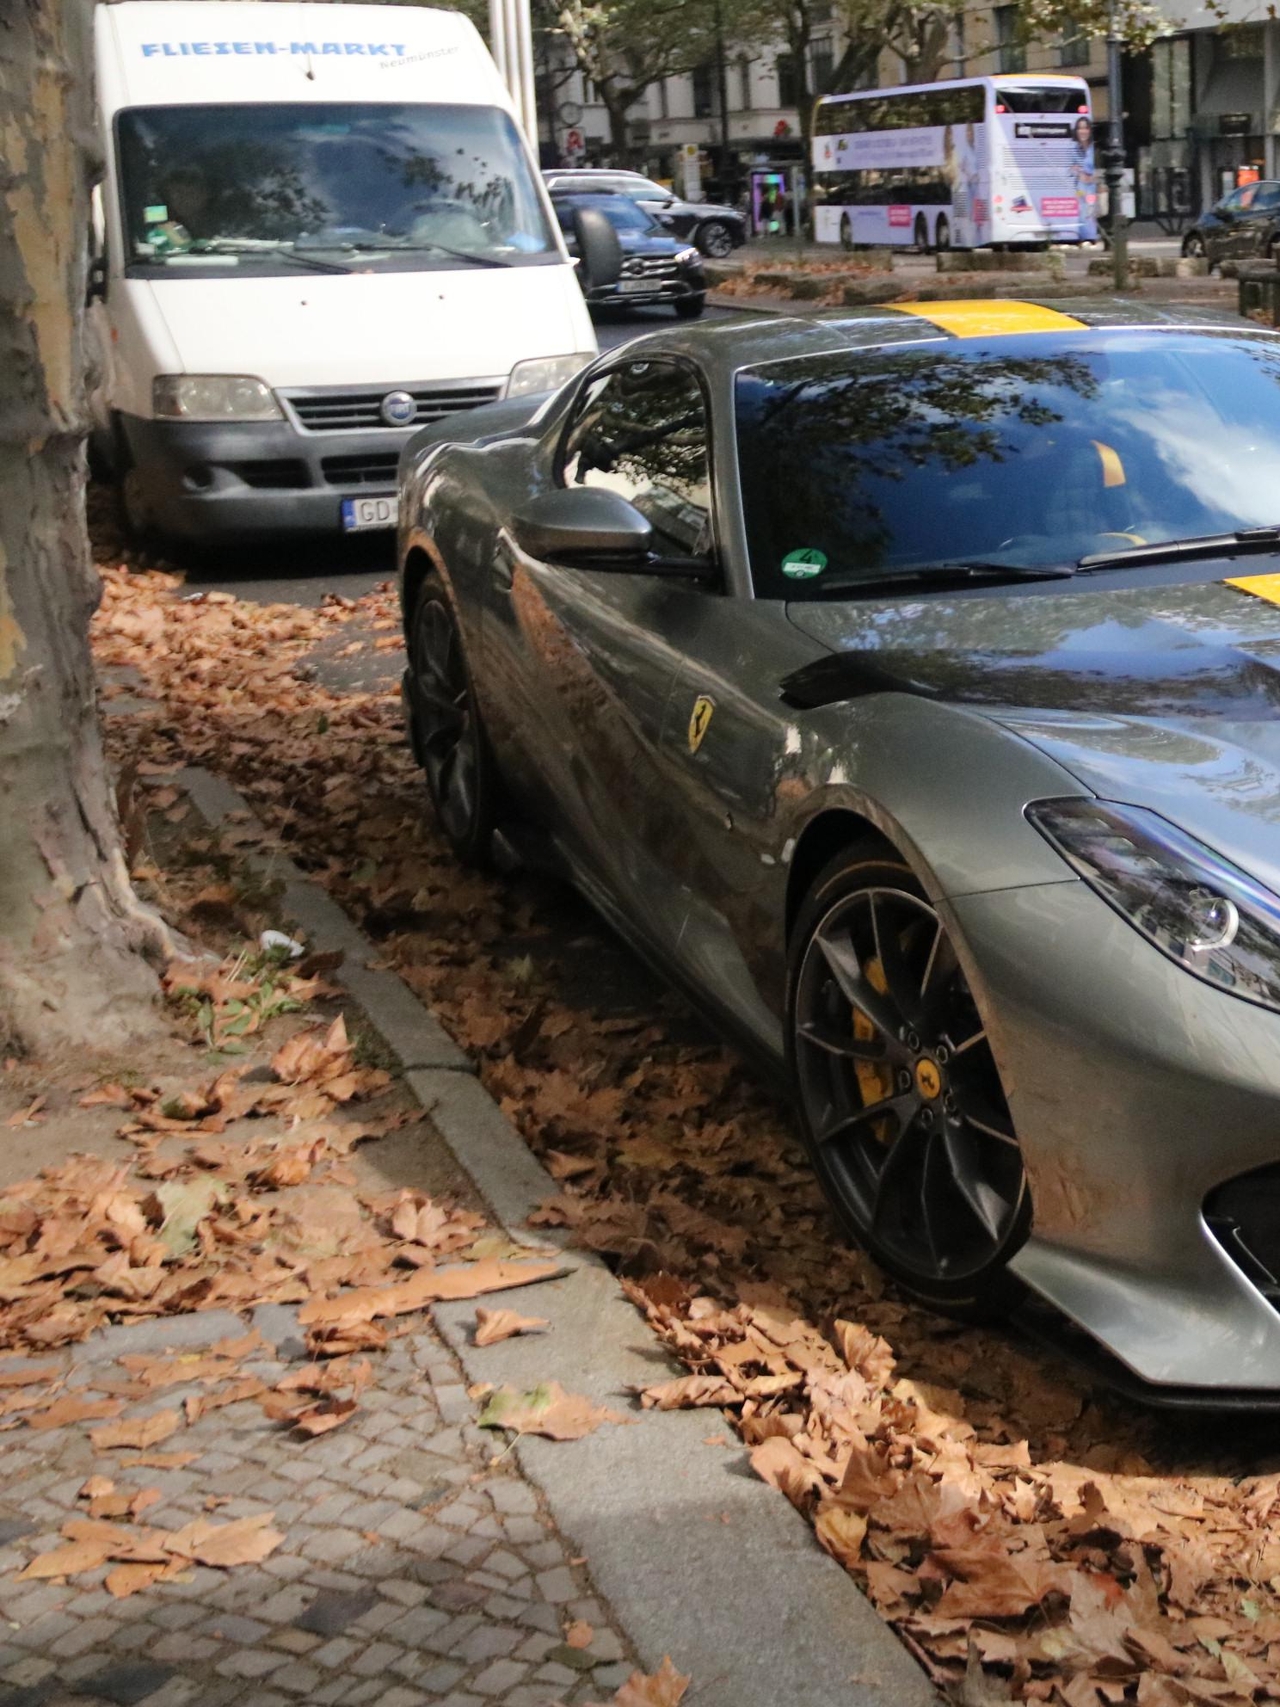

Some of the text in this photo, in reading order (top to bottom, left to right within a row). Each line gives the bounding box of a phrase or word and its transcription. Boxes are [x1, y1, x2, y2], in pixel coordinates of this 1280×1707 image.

[141, 42, 406, 57] FLIESEN-MARKT
[379, 46, 459, 69] Neumünster
[361, 501, 390, 521] GD
